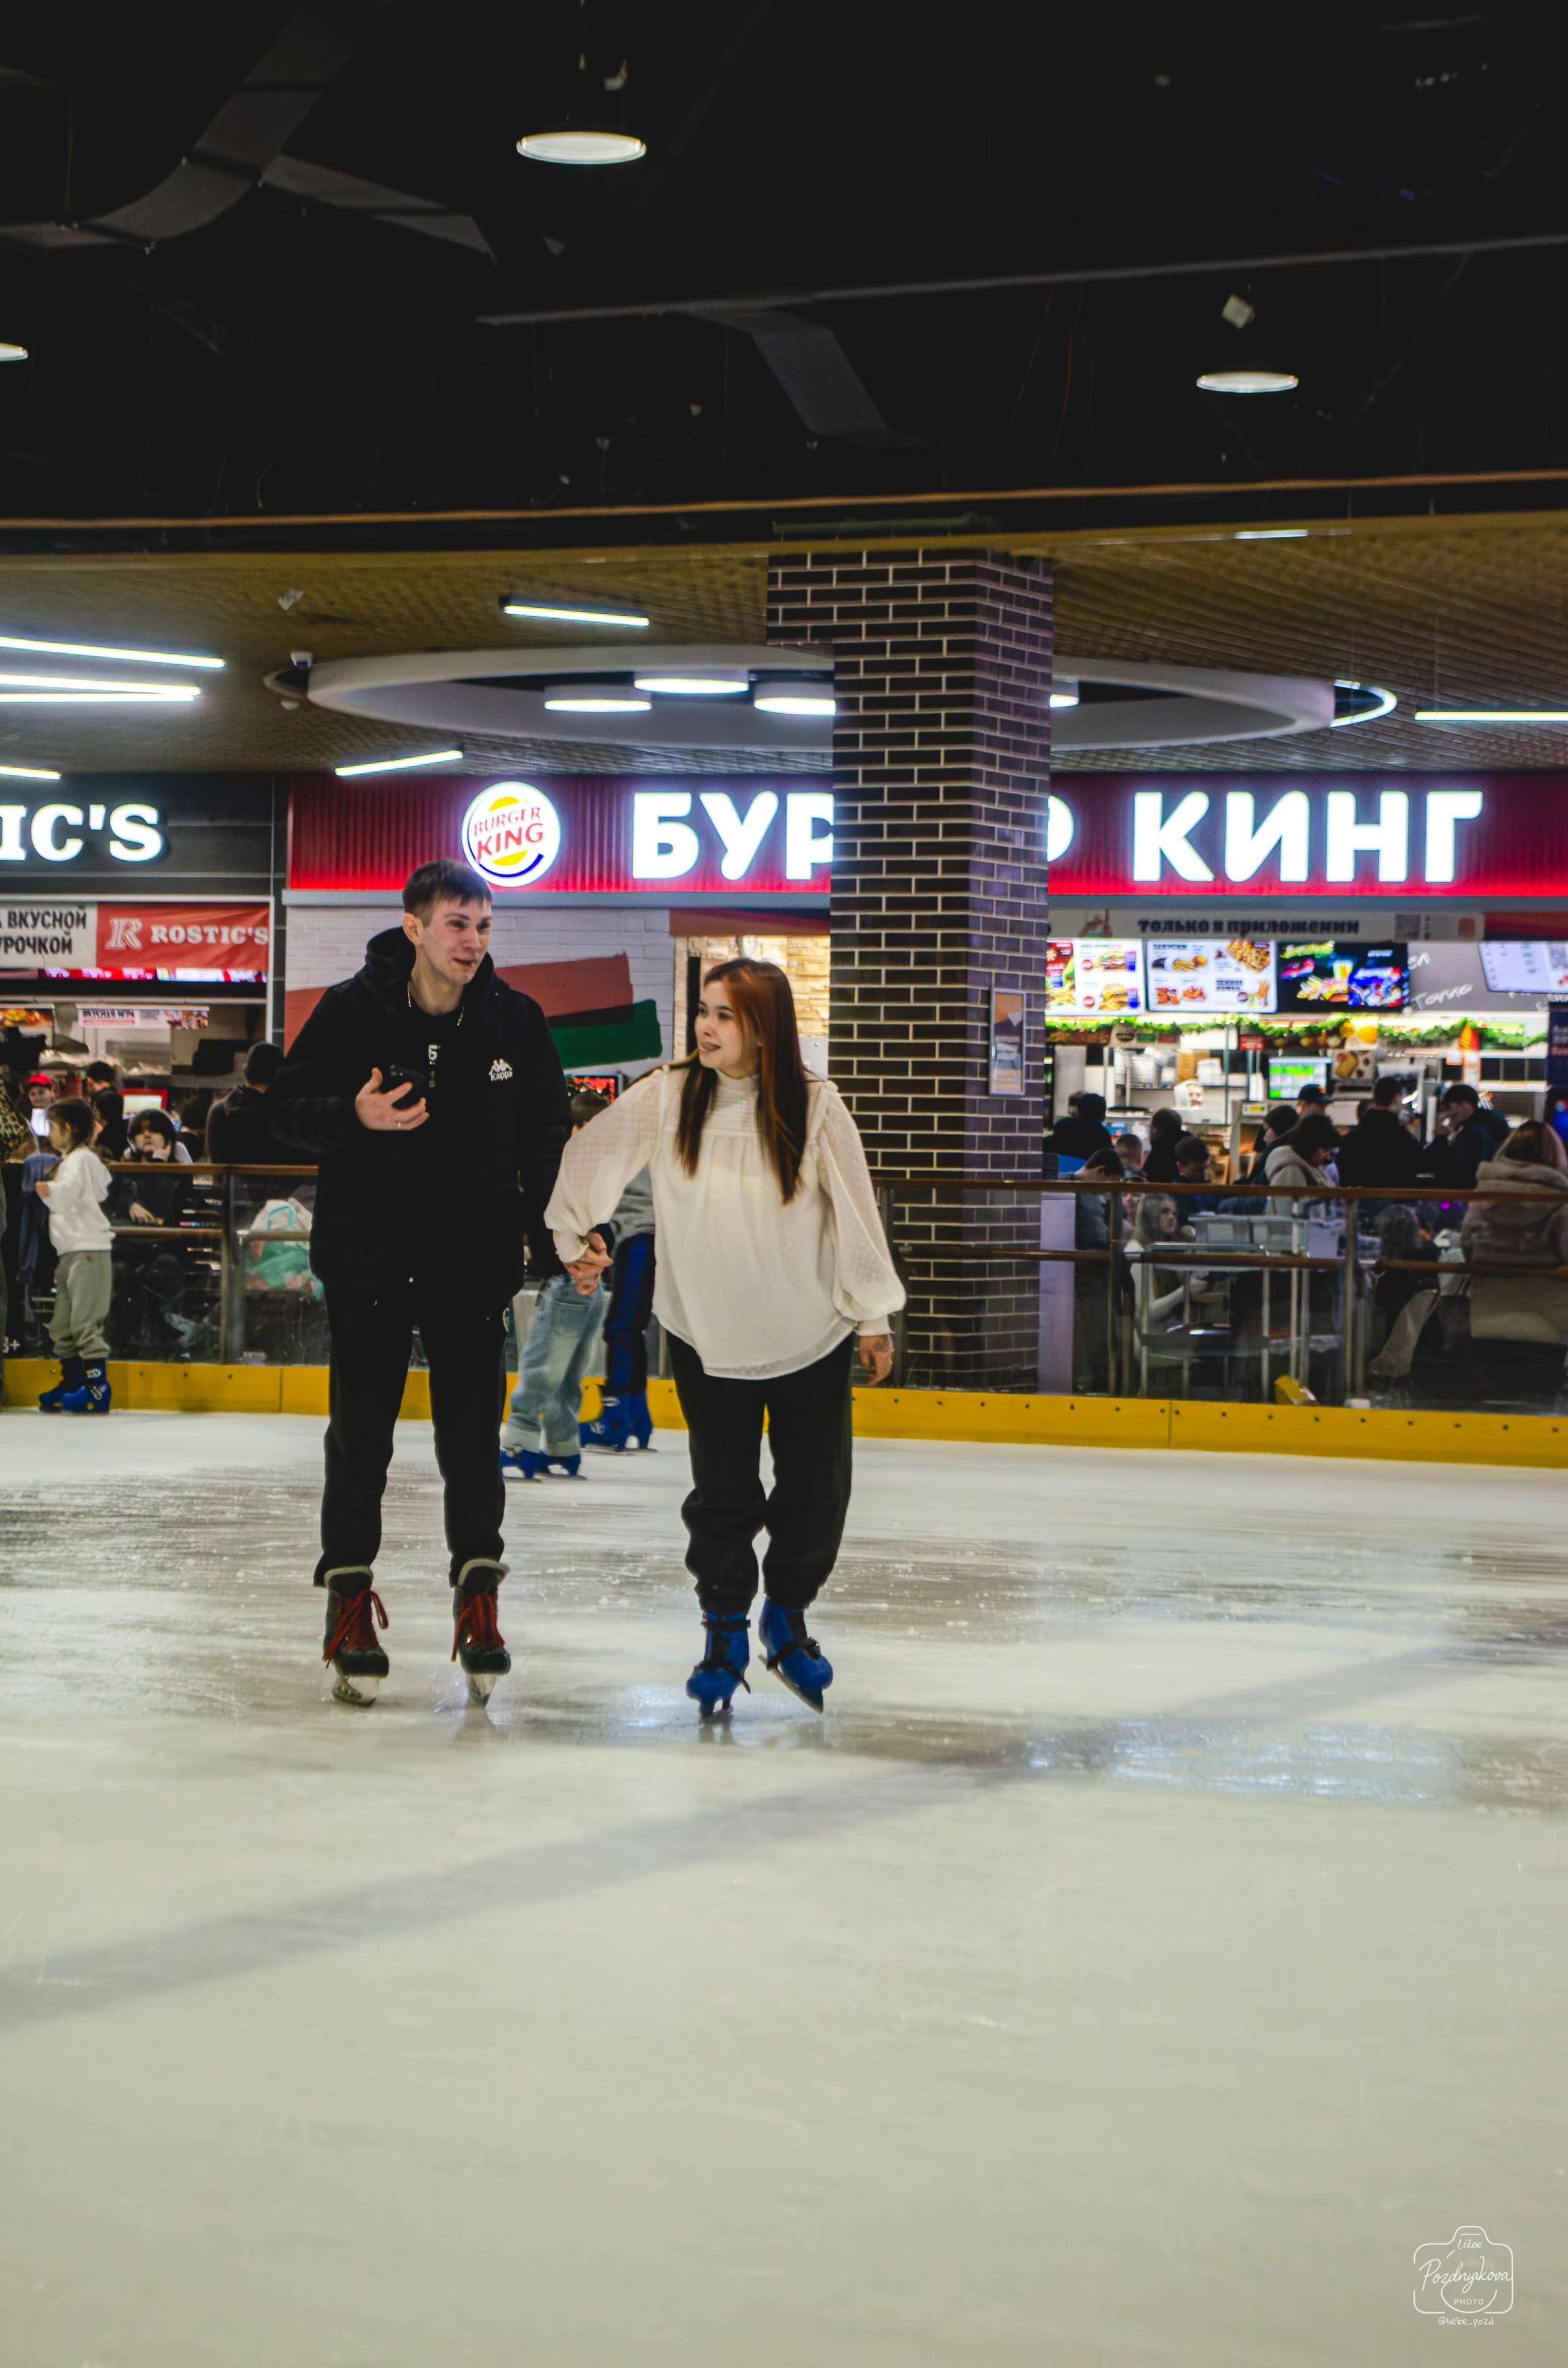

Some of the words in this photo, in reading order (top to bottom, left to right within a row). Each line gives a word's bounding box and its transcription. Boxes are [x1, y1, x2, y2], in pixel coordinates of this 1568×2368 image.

[0, 803, 164, 861] IC'S
[473, 807, 541, 837] BURGER
[1133, 790, 1482, 882] КИНГ
[477, 823, 543, 863] KING
[7, 907, 86, 929] ВКУСНОЙ
[1137, 919, 1209, 933] только
[0, 931, 73, 955] РОЧКОЙ
[105, 918, 143, 950] R
[151, 925, 269, 945] ROSTIC'S
[491, 1070, 513, 1081] Kappa
